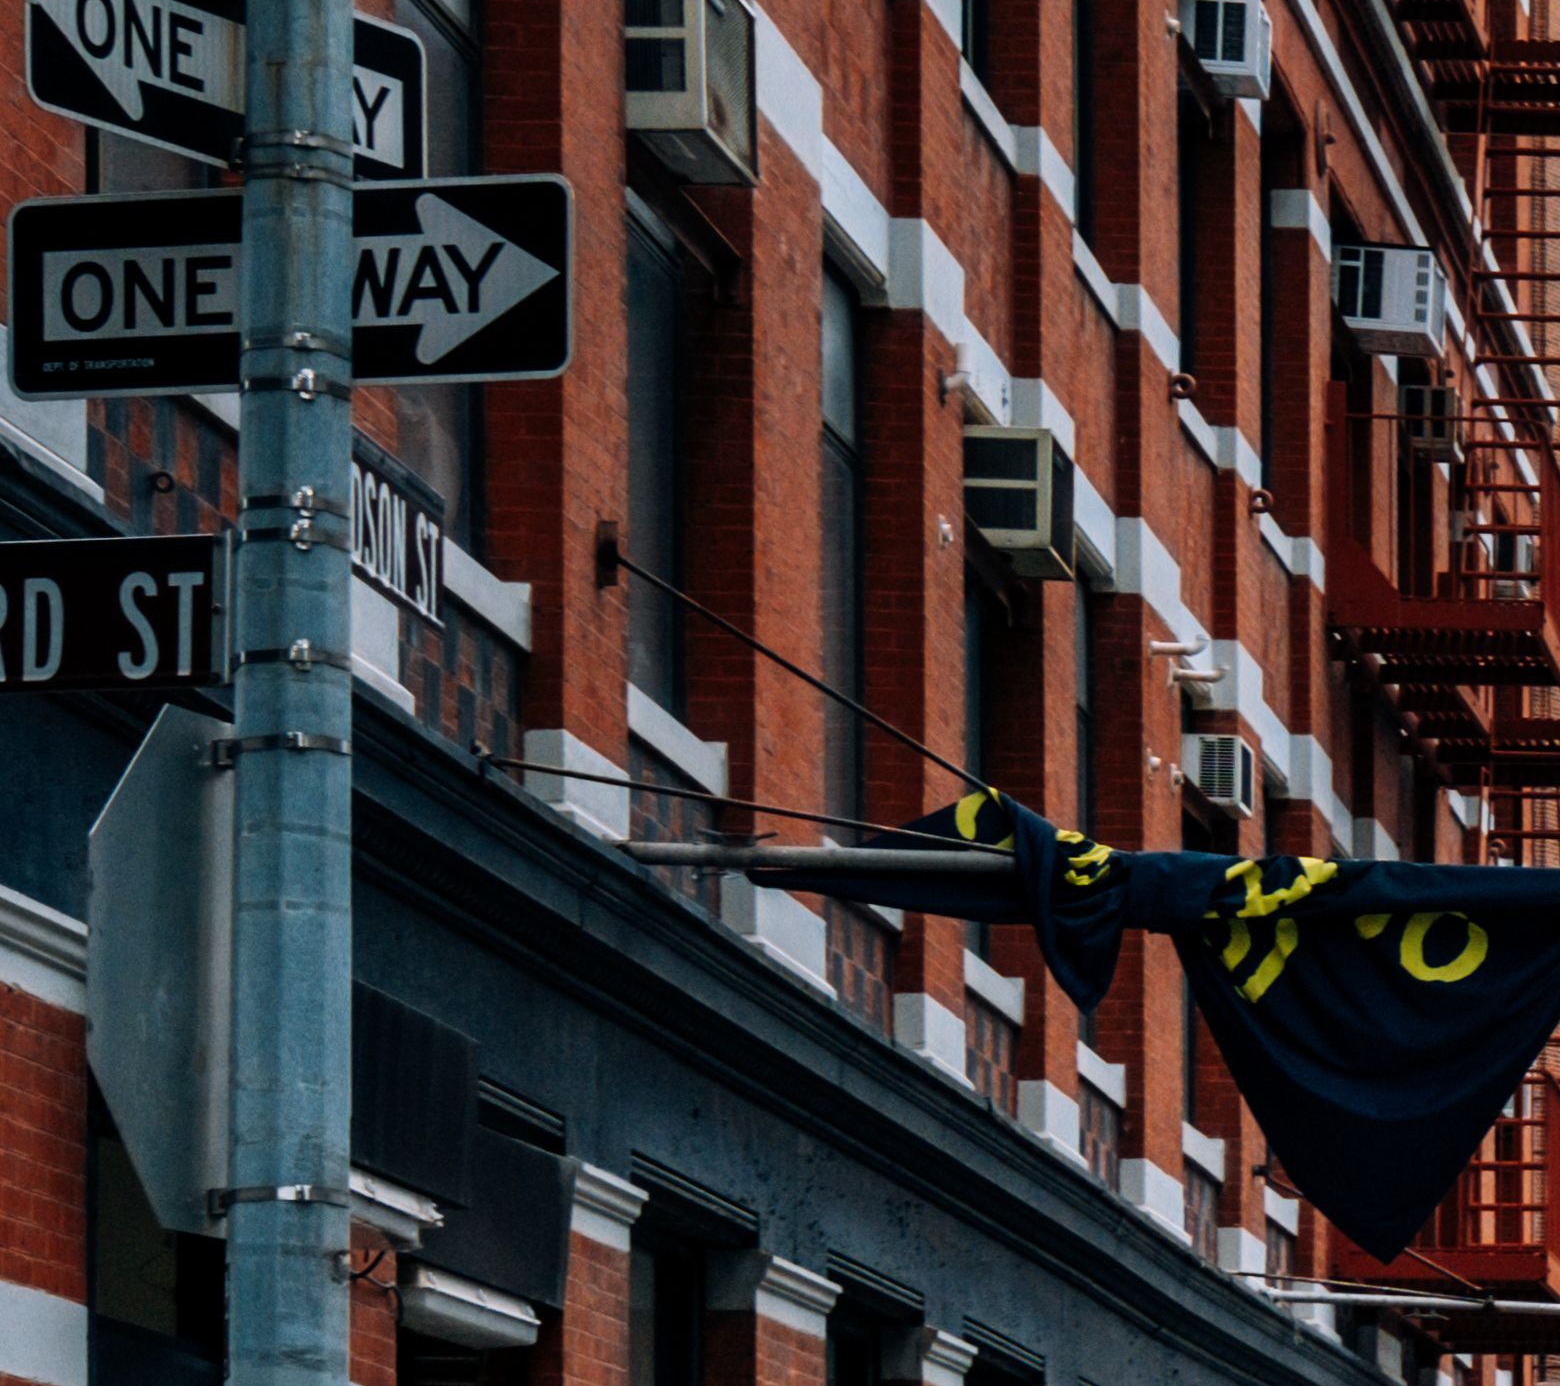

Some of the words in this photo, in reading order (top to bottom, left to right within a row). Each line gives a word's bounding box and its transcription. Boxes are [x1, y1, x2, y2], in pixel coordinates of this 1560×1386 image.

[61, 255, 233, 333] ONE
[353, 241, 506, 320] WAY
[415, 512, 441, 619] ST
[117, 571, 205, 681] ST
